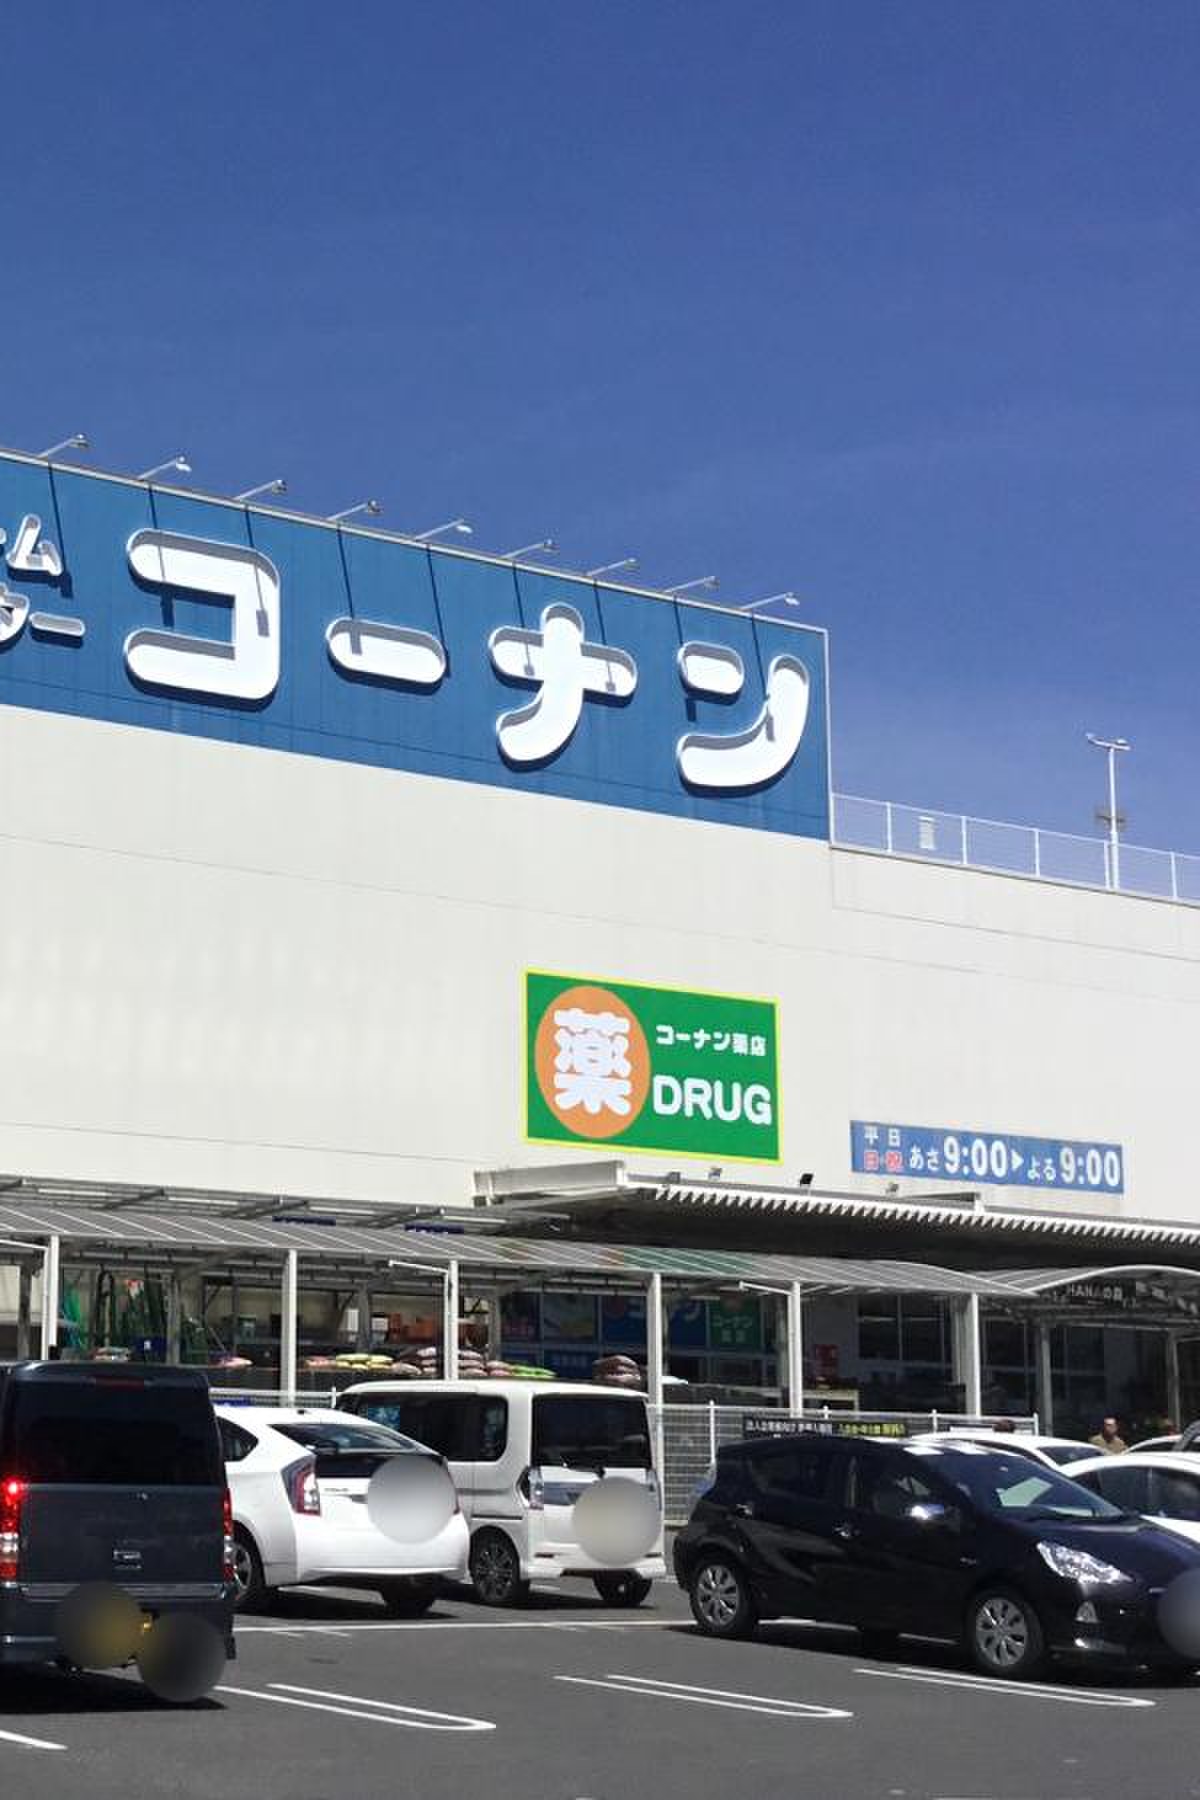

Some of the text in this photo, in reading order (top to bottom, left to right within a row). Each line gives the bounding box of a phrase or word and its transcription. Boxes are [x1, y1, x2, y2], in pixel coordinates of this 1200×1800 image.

[124, 527, 810, 788] コーナン
[553, 1007, 633, 1117] 薬
[652, 1073, 774, 1126] DRUG
[864, 1125, 900, 1147] 平日
